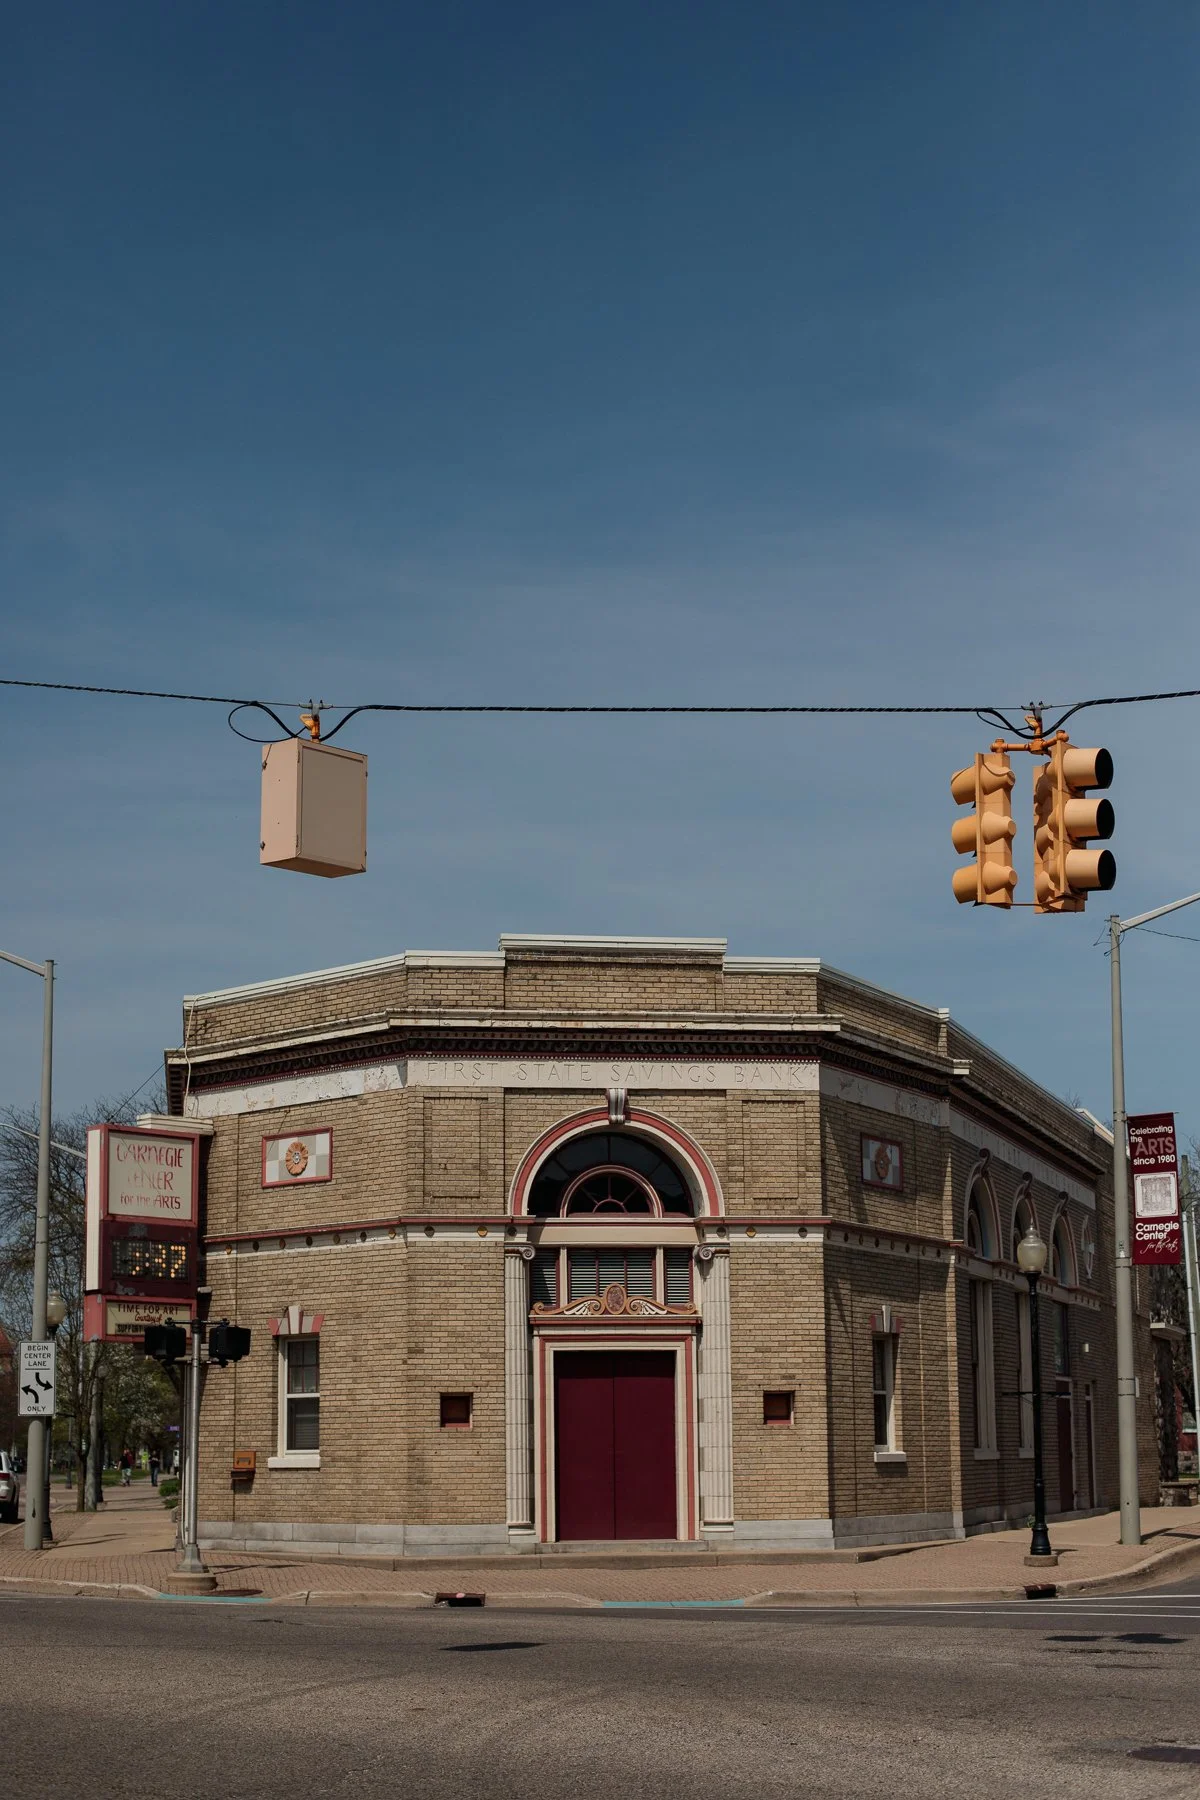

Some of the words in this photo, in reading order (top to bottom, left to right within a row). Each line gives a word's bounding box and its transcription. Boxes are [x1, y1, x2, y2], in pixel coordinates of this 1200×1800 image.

[426, 1062, 499, 1081] FIRST
[517, 1063, 593, 1082] STATE
[610, 1064, 717, 1083] SAVINGS
[736, 1066, 806, 1084] BANK
[1130, 1125, 1174, 1136] Celebrating
[1130, 1136, 1143, 1144] the
[1135, 1137, 1175, 1156] ARTS
[117, 1143, 184, 1168] CARNEGIE
[1133, 1157, 1156, 1165] since
[1157, 1154, 1176, 1164] 1980
[153, 1194, 182, 1210] ARTS
[1136, 1221, 1179, 1233] Carnegie
[1135, 1231, 1168, 1241] Center
[118, 1303, 141, 1314] TIME
[143, 1304, 160, 1314] FOR
[163, 1306, 180, 1315] ART
